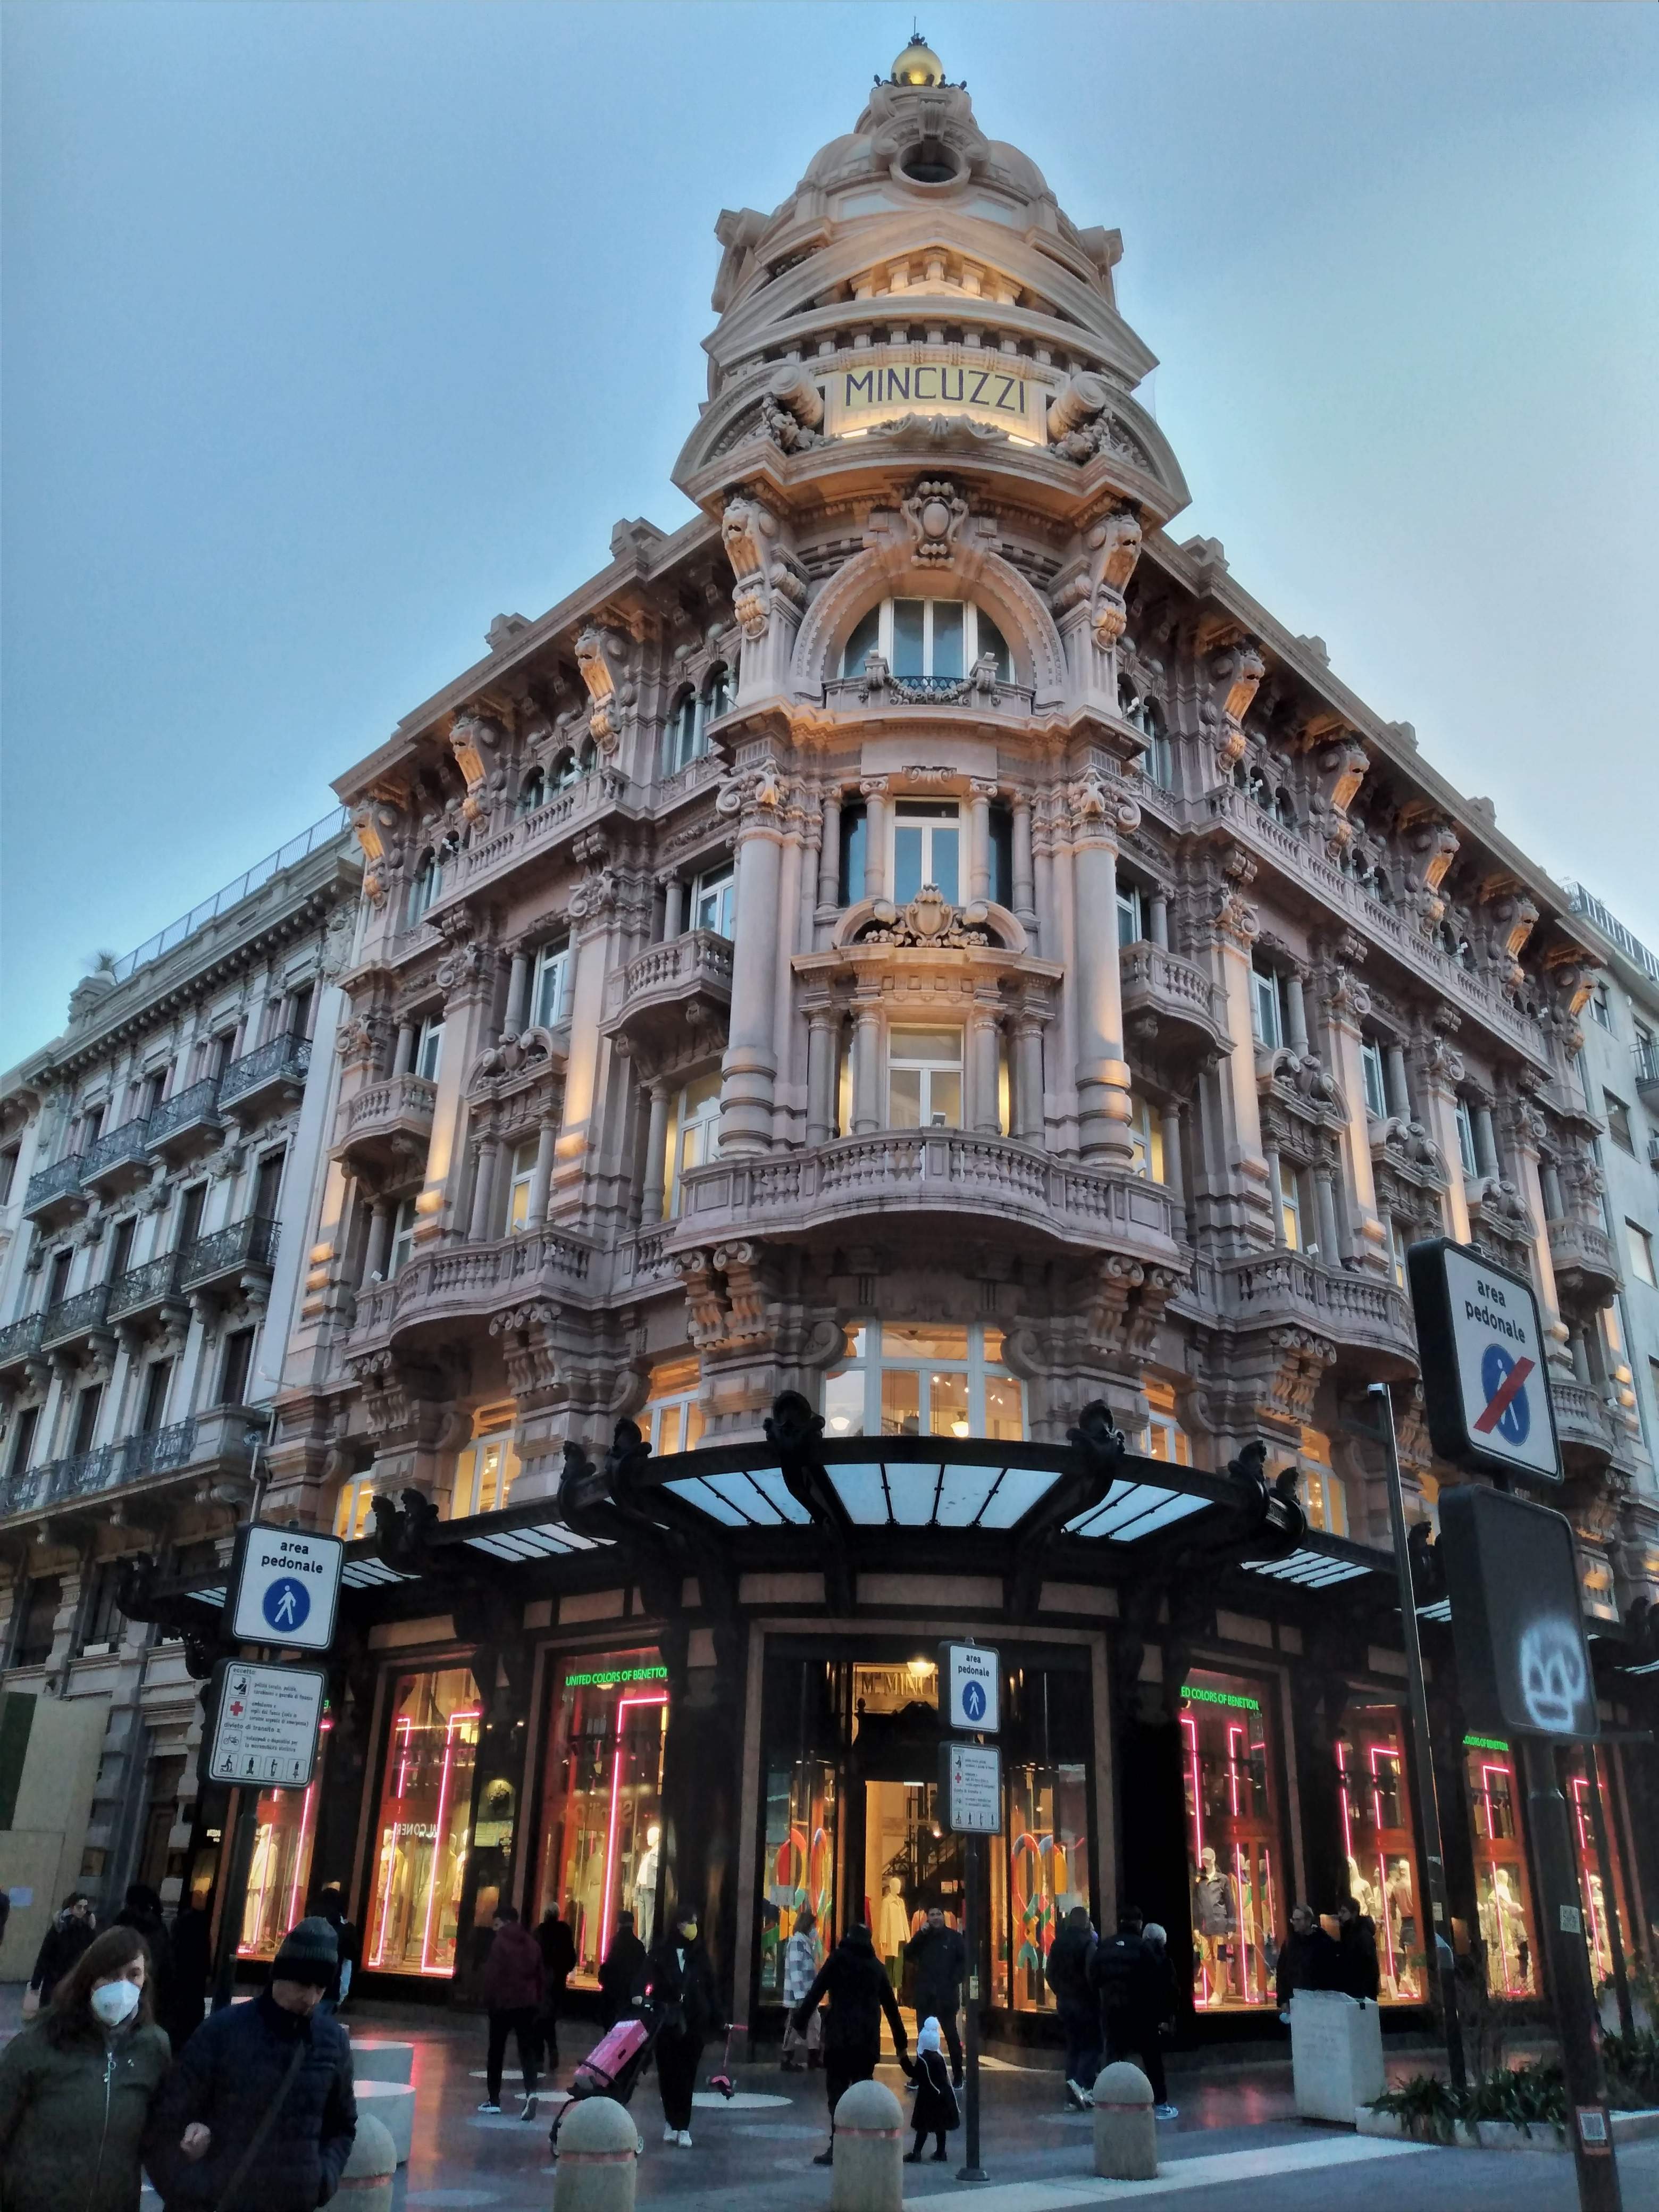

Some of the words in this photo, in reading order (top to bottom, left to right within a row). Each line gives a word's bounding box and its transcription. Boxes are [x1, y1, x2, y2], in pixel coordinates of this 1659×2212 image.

[845, 367, 1025, 414] MINCUZZI
[1477, 1280, 1506, 1308] area
[1465, 1300, 1526, 1344] pedonale
[280, 1542, 309, 1555] area
[261, 1555, 323, 1574] pedonale
[966, 1654, 981, 1664] area
[565, 1674, 591, 1686] UNITED
[592, 1671, 621, 1684] COLORS
[621, 1670, 632, 1681] OF
[958, 1665, 990, 1677] pedonale
[1191, 1688, 1217, 1703] COLORS
[1218, 1693, 1227, 1705] OF
